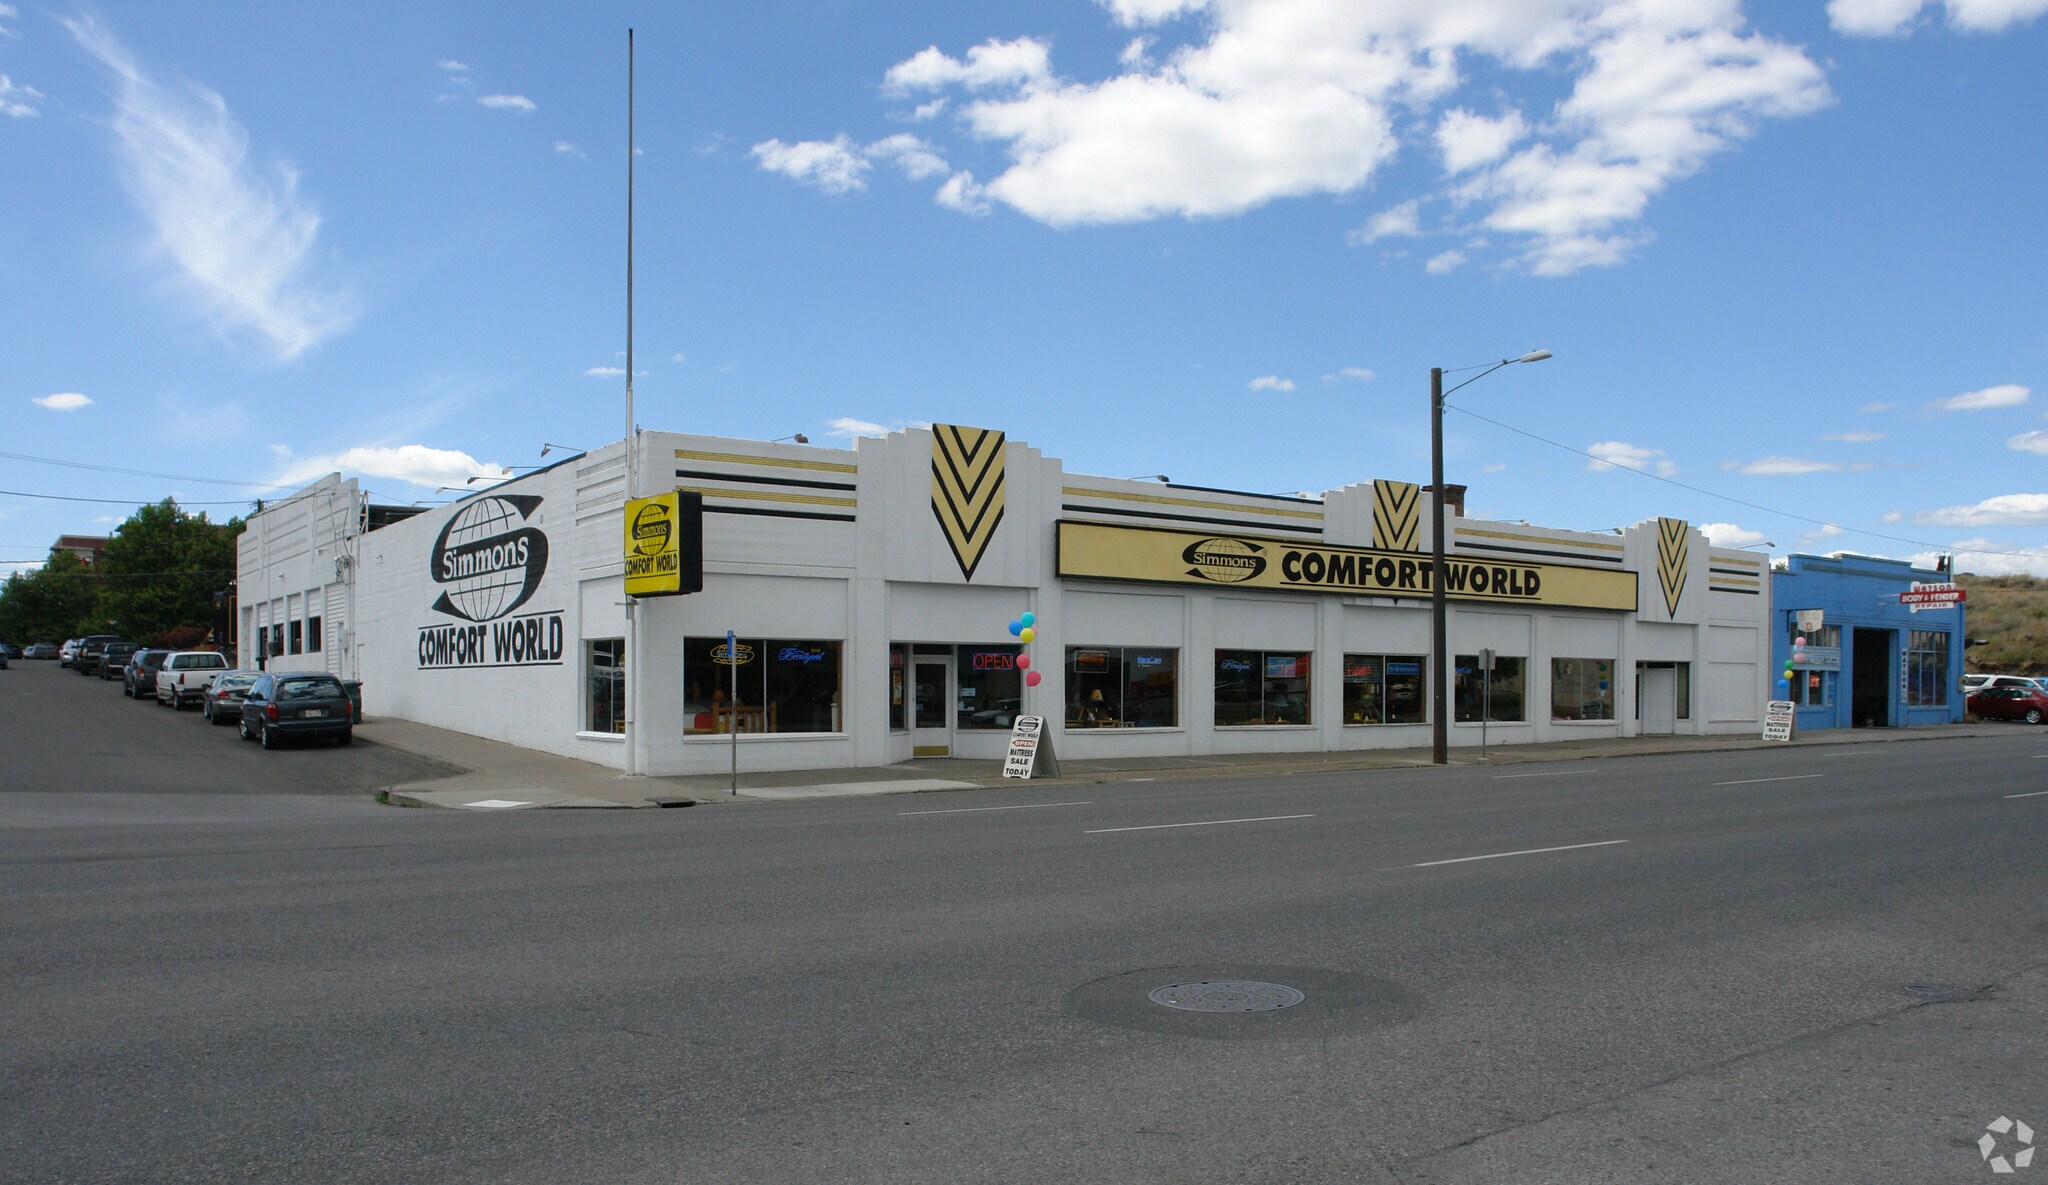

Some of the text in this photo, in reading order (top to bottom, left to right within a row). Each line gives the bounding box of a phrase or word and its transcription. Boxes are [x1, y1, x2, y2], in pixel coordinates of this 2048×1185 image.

[637, 522, 667, 538] Simmons
[443, 536, 529, 580] Simmons
[625, 553, 678, 576] COMFORT WORLD
[1193, 552, 1256, 568] Simmons
[1281, 550, 1541, 596] COMFORT WORLD
[1902, 594, 1923, 603] BODY
[1931, 592, 1960, 602] FENDER
[418, 615, 563, 667] COMFORT WORLD
[974, 654, 1012, 669] OPEN
[1009, 748, 1034, 757] MATTRESS
[1005, 768, 1030, 776] TODAY
